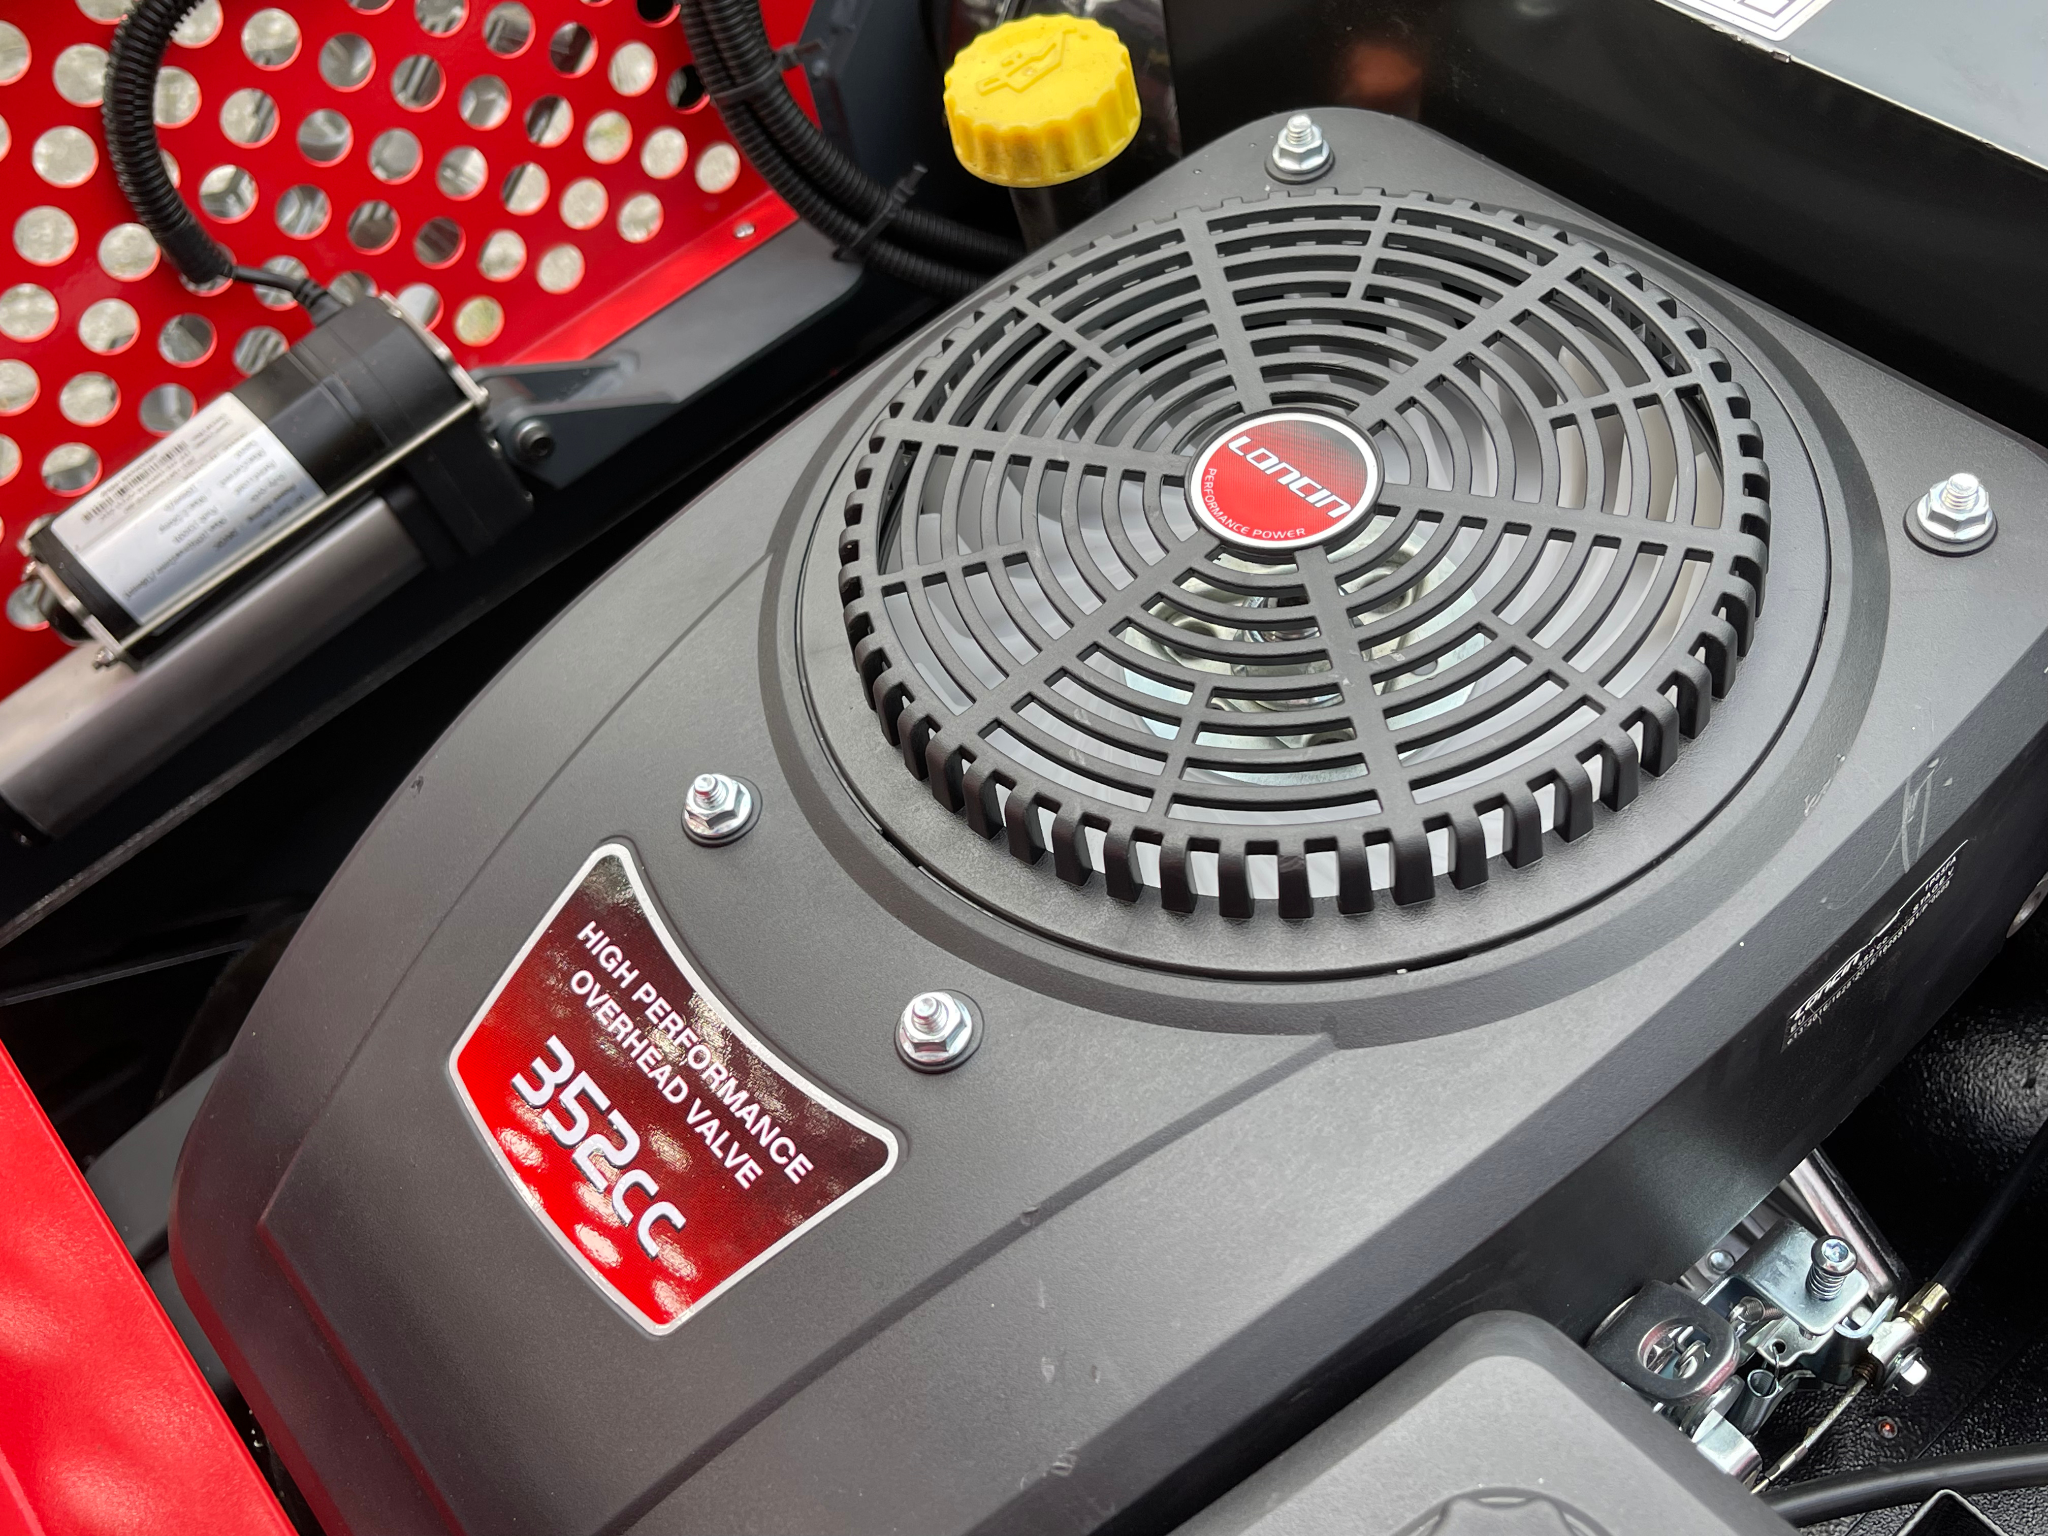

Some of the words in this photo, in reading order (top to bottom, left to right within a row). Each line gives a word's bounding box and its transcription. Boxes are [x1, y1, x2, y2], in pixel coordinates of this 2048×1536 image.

[1203, 467, 1250, 535] PERFORMANCE
[1252, 528, 1306, 539] POWER
[1912, 875, 1946, 913] STAGE
[511, 1035, 687, 1259] 352cc
[571, 969, 689, 1103] OVERHEAD
[686, 1098, 763, 1190] VALVE
[577, 921, 640, 989] HIGH
[632, 982, 814, 1184] PERFORMANCE
